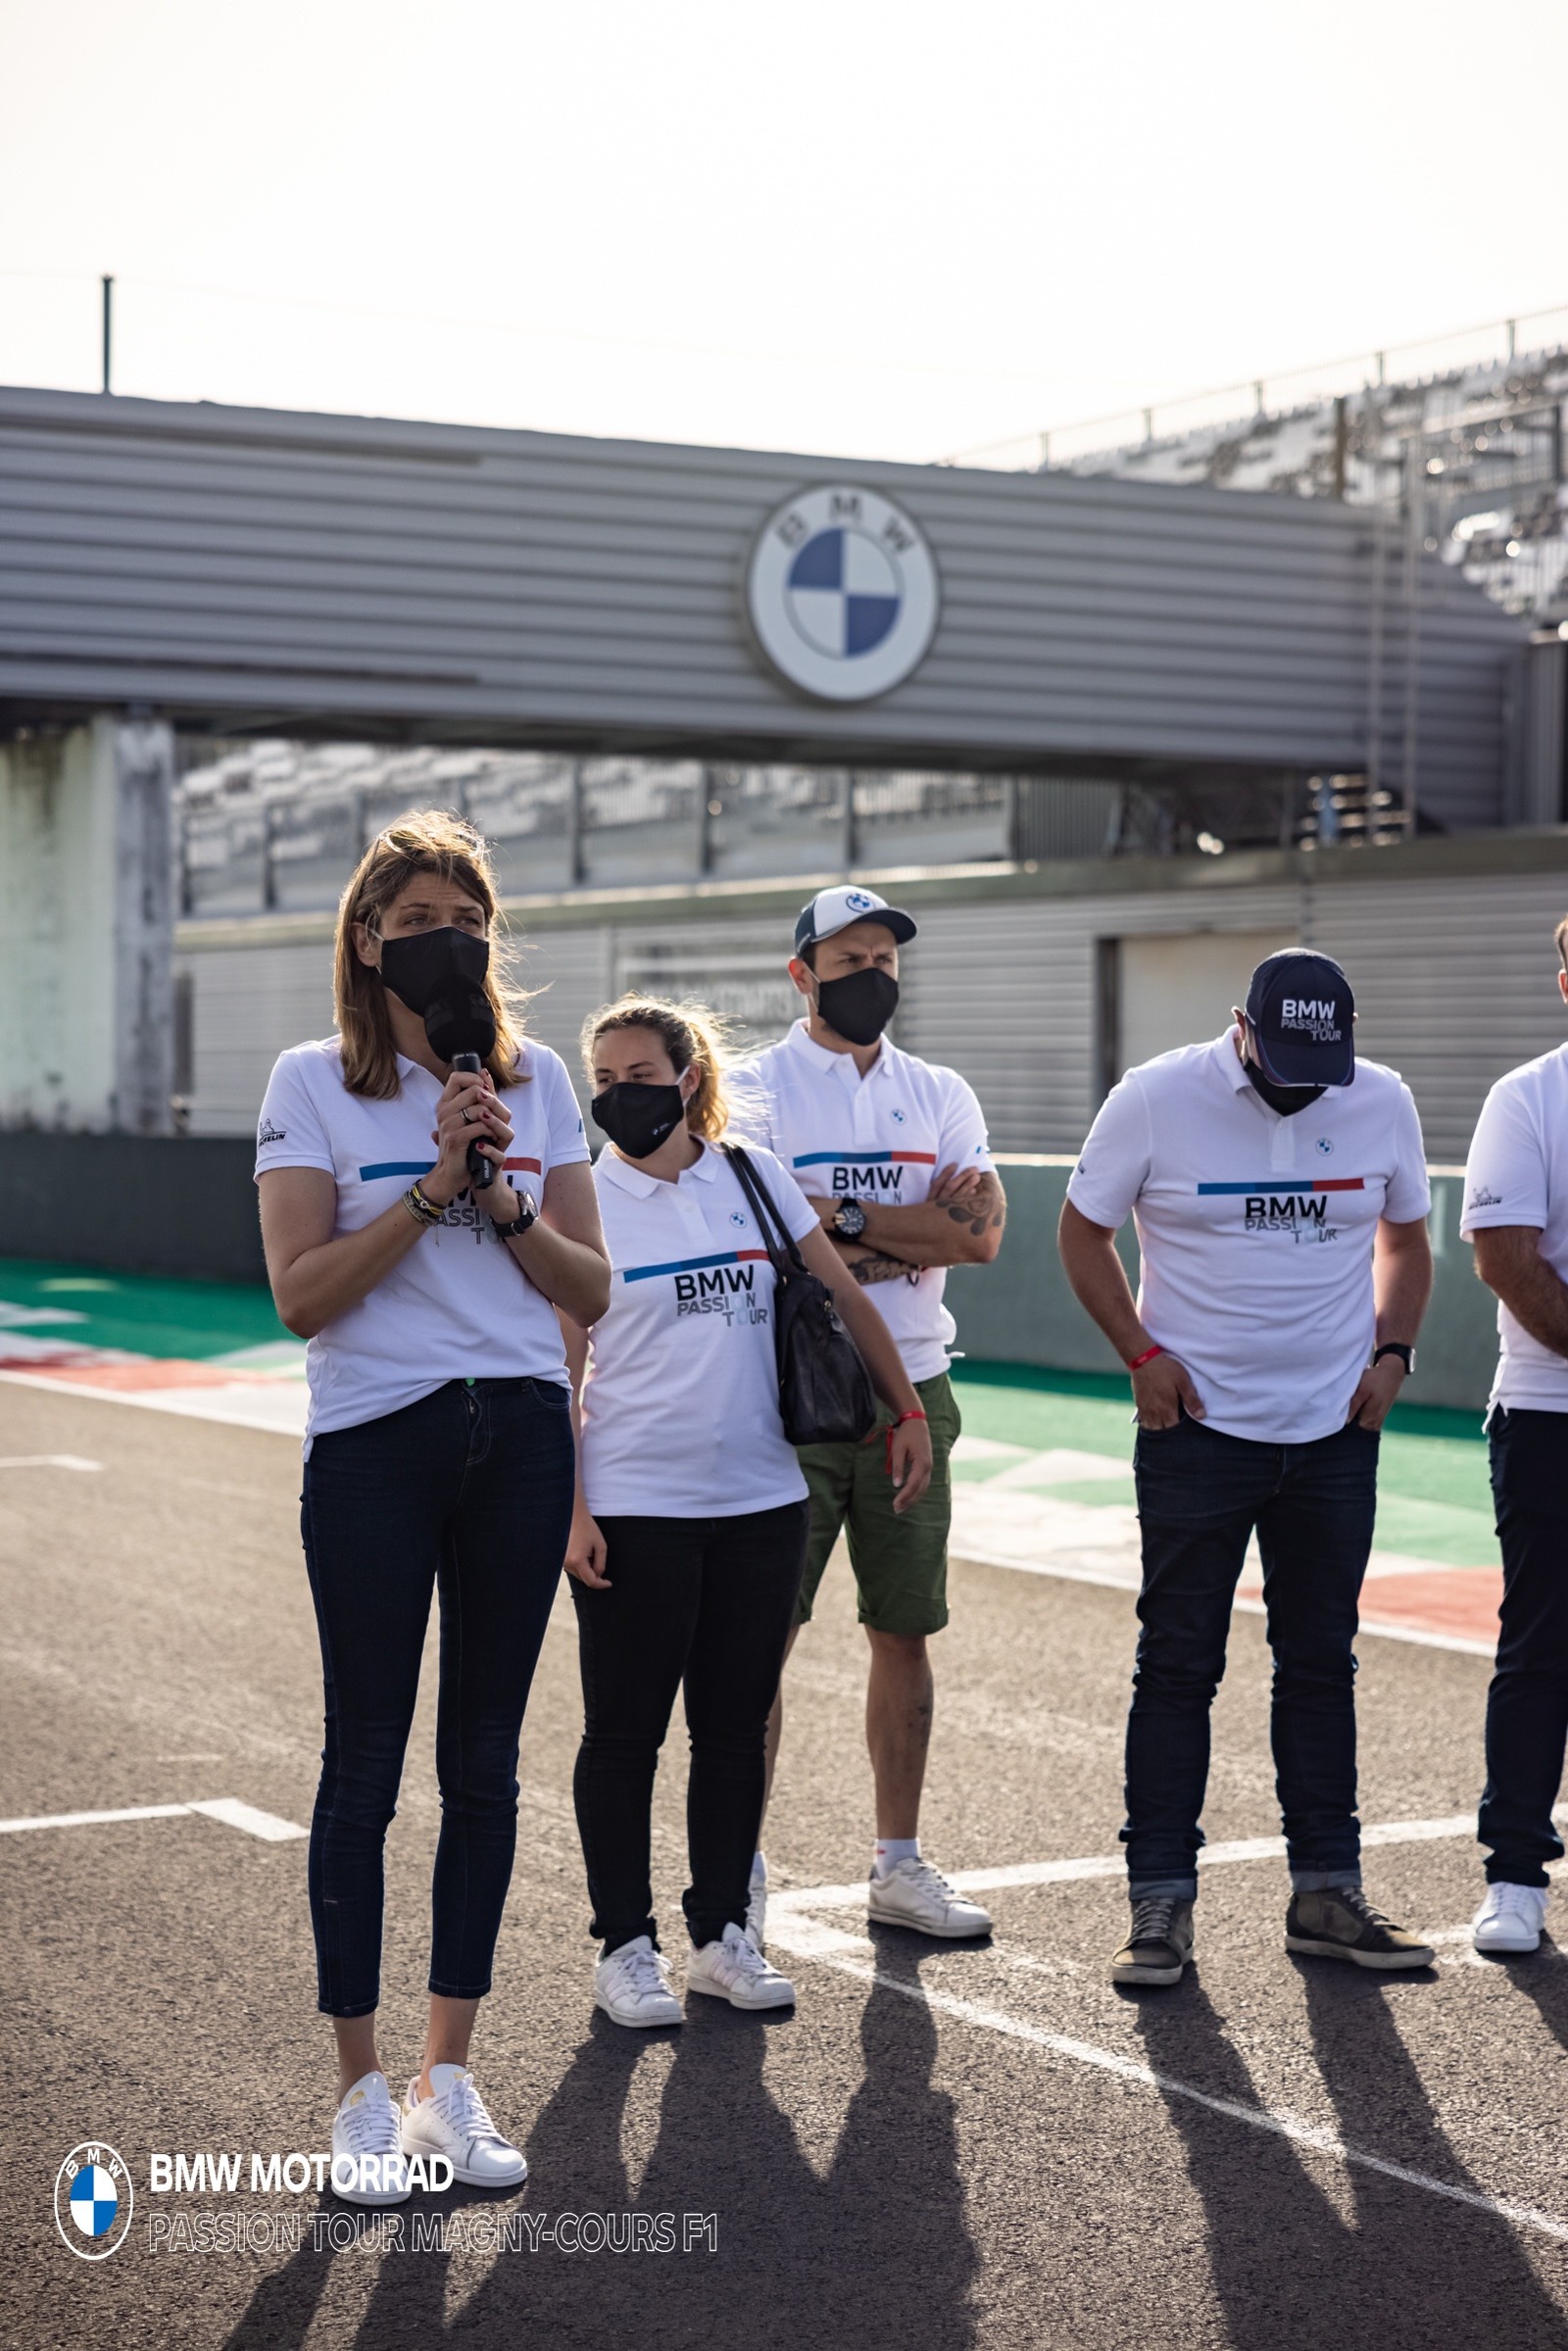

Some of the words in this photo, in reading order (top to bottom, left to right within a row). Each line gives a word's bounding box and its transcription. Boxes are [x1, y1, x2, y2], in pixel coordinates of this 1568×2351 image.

[776, 494, 915, 554] BMW
[1282, 999, 1335, 1020] BMW
[1280, 1017, 1335, 1031] PASSION
[1310, 1029, 1342, 1042] TOUR
[832, 1165, 904, 1191] BMW
[1245, 1195, 1327, 1219] BMW
[1245, 1216, 1327, 1231] PASSION
[1290, 1229, 1338, 1245] TOUR
[674, 1264, 754, 1301] BMW
[677, 1293, 756, 1317] PASSION
[722, 1308, 768, 1327] TOUR
